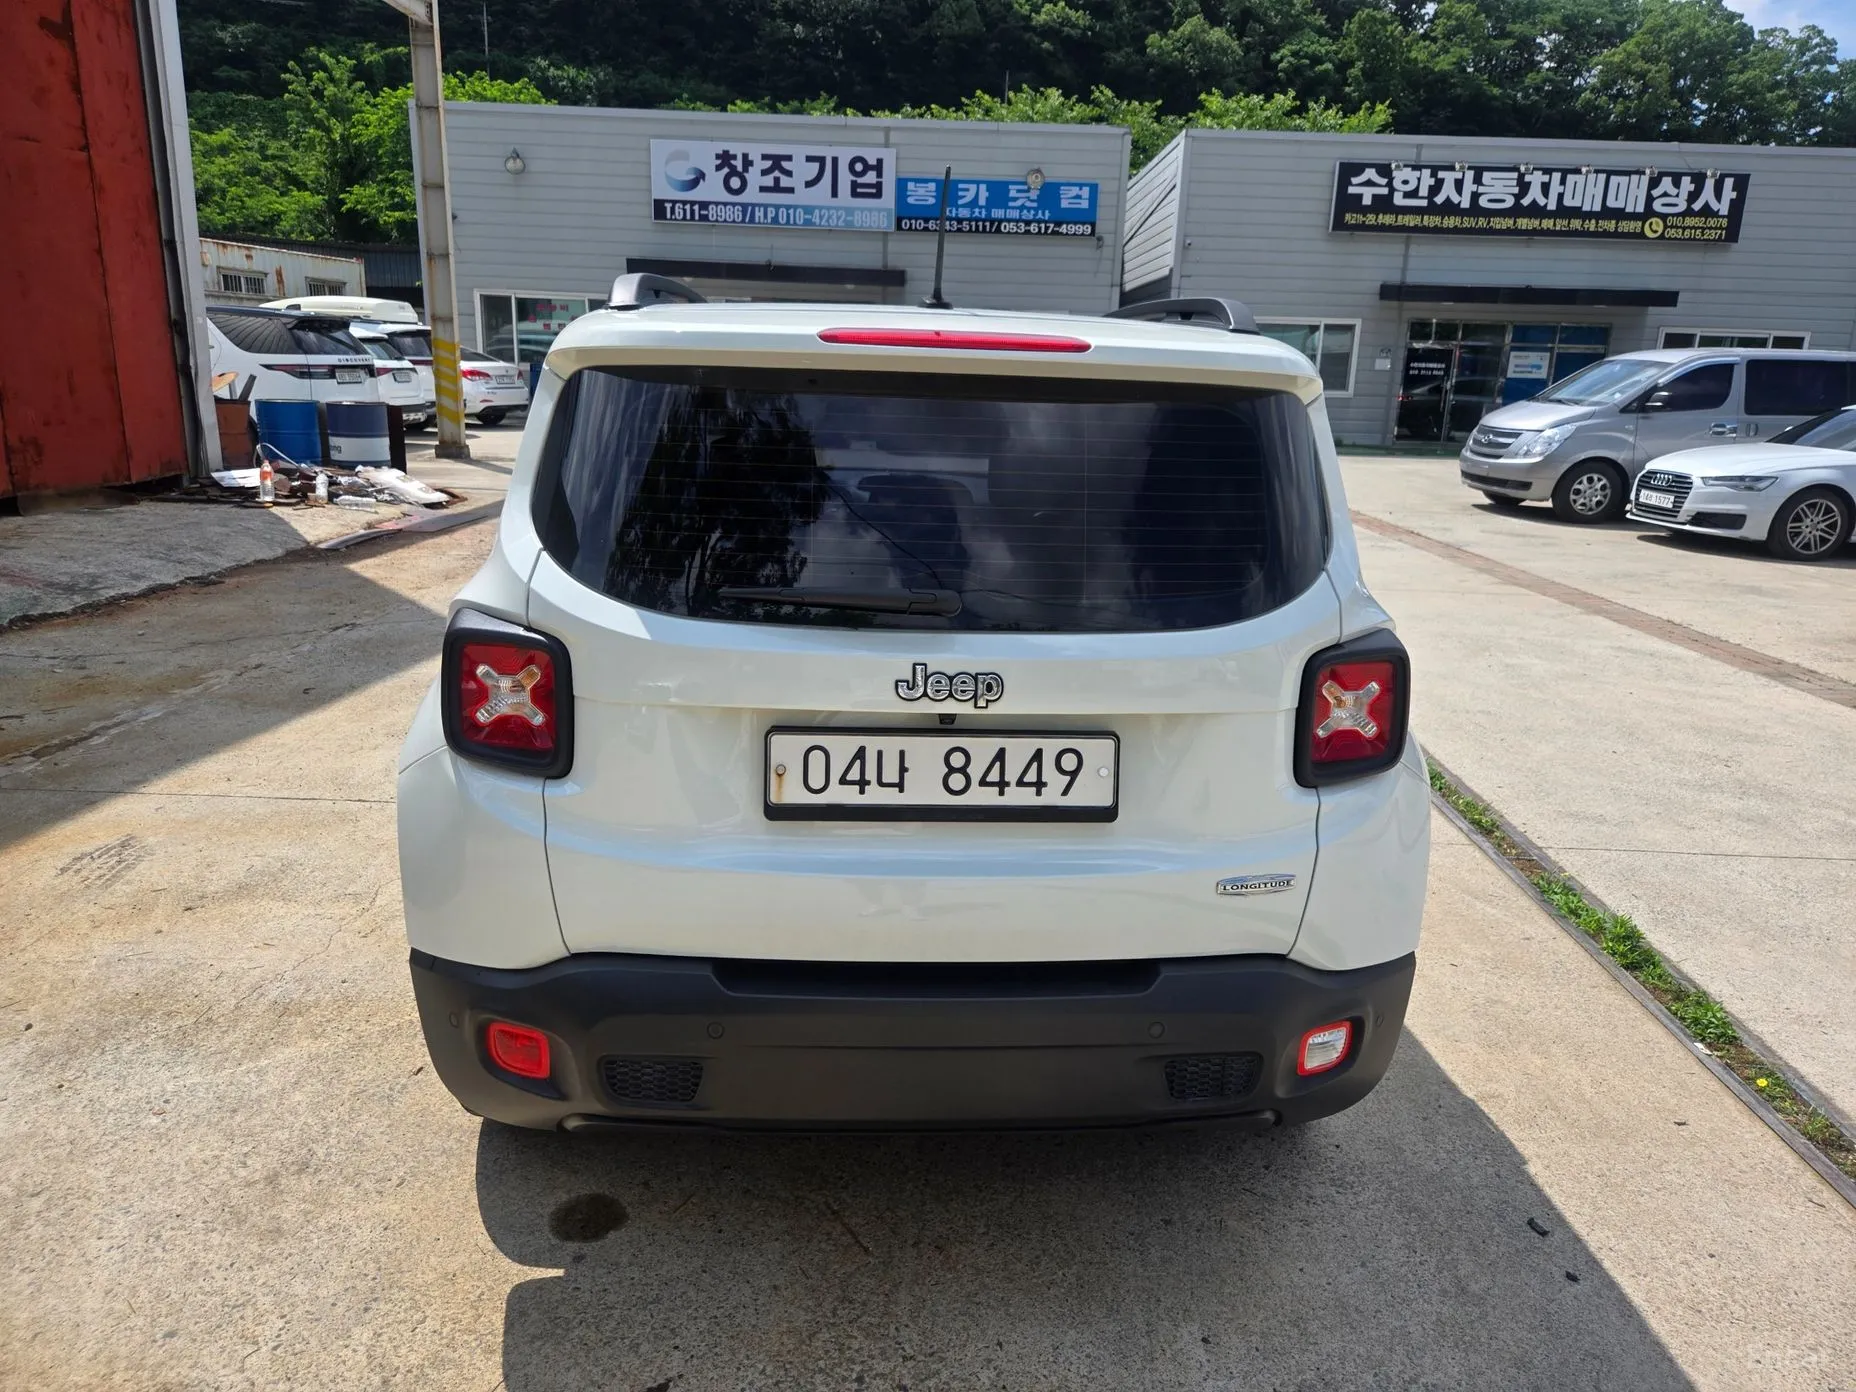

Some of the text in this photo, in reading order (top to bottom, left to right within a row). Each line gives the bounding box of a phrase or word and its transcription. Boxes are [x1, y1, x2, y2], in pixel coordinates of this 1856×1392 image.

[715, 149, 885, 200] 창조기업
[1347, 167, 1737, 216] 수한자동차매매상사
[664, 202, 743, 222] T.611-8986
[946, 207, 1051, 221] 자동차 매매상사
[1001, 221, 1092, 236] 053-617-4999
[894, 662, 1005, 710] Jeep
[801, 744, 1086, 798] 04나 8449
[1222, 879, 1296, 892] LONGITUDE
